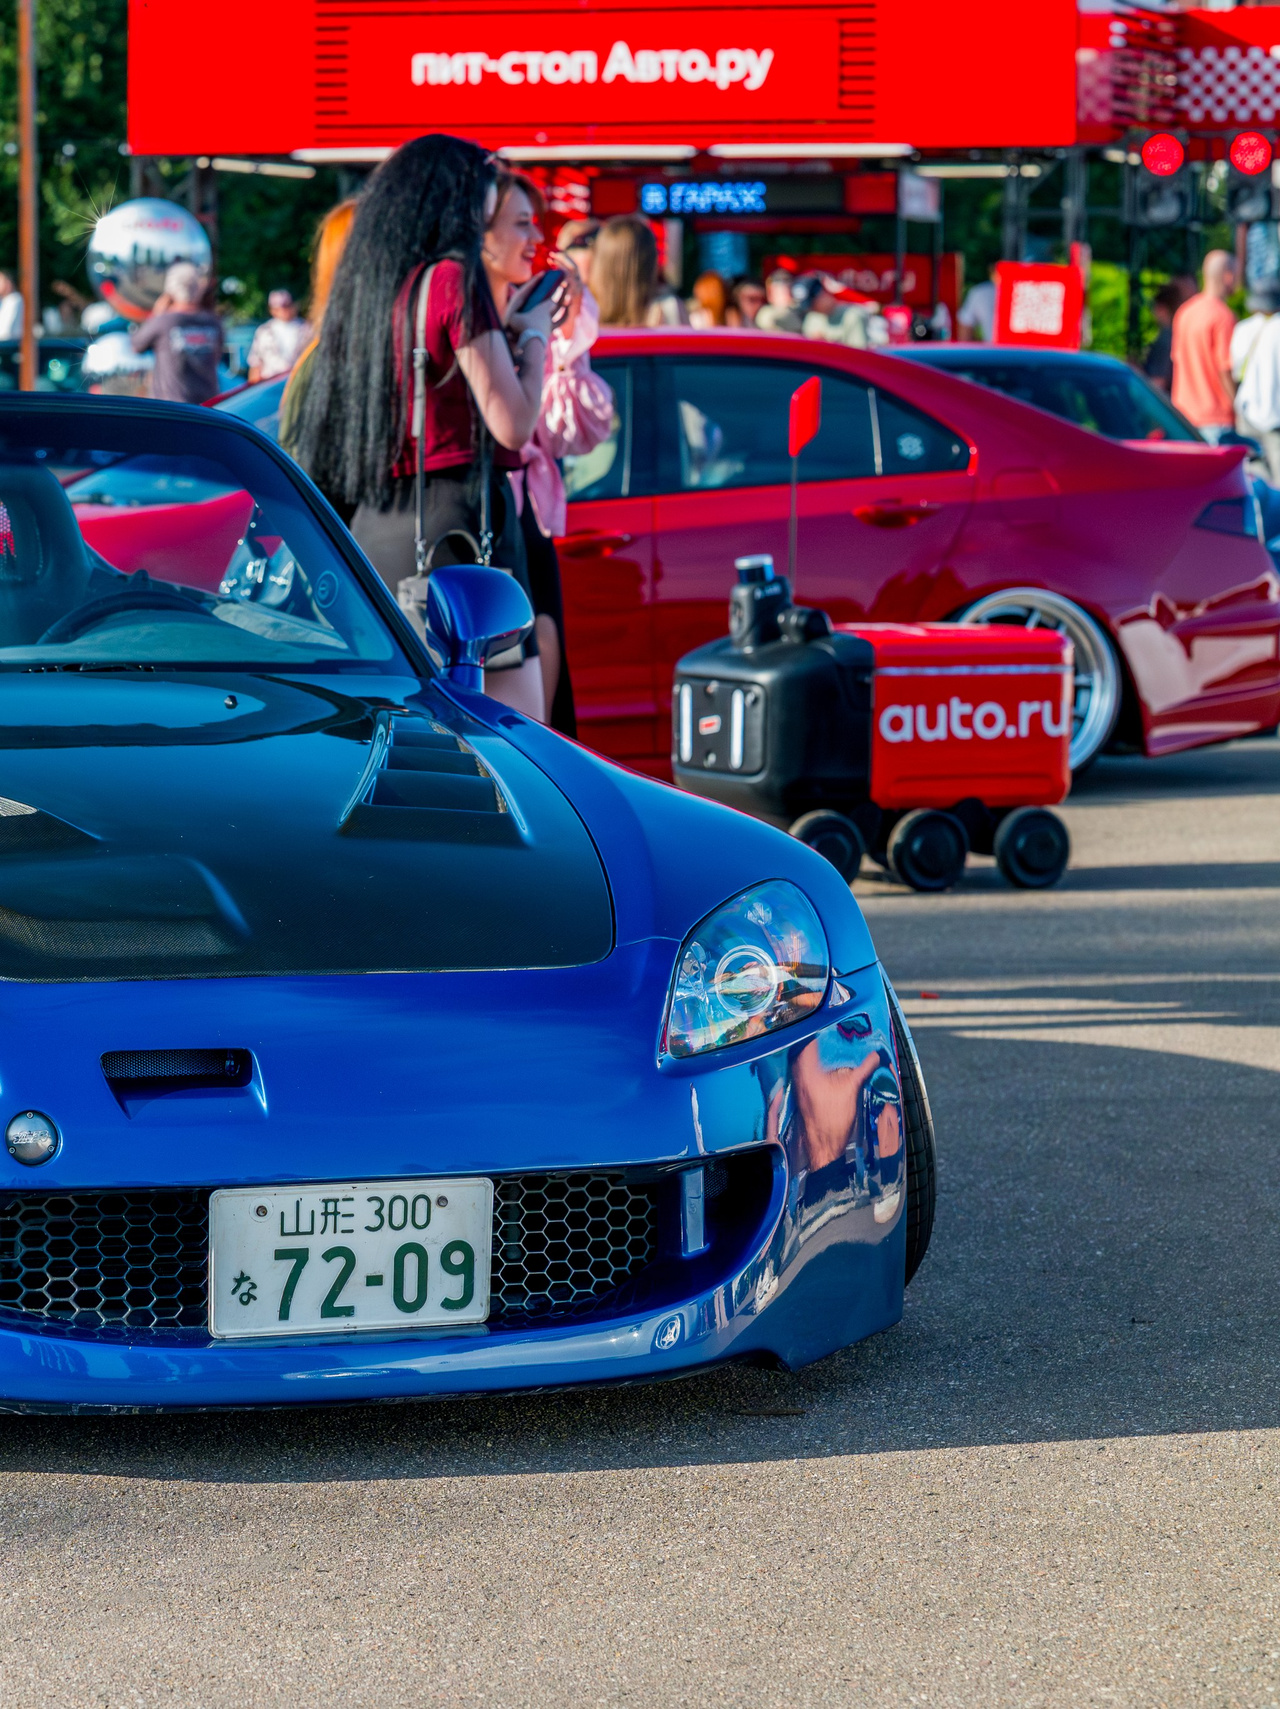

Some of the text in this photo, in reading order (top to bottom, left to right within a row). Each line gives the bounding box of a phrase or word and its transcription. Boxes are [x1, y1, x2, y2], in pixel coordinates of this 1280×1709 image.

[411, 40, 775, 91] пит-стоп Авто.ру
[879, 696, 1069, 744] auto.ru
[280, 1194, 432, 1237] 山形 300
[230, 1240, 476, 1322] な 72-09
